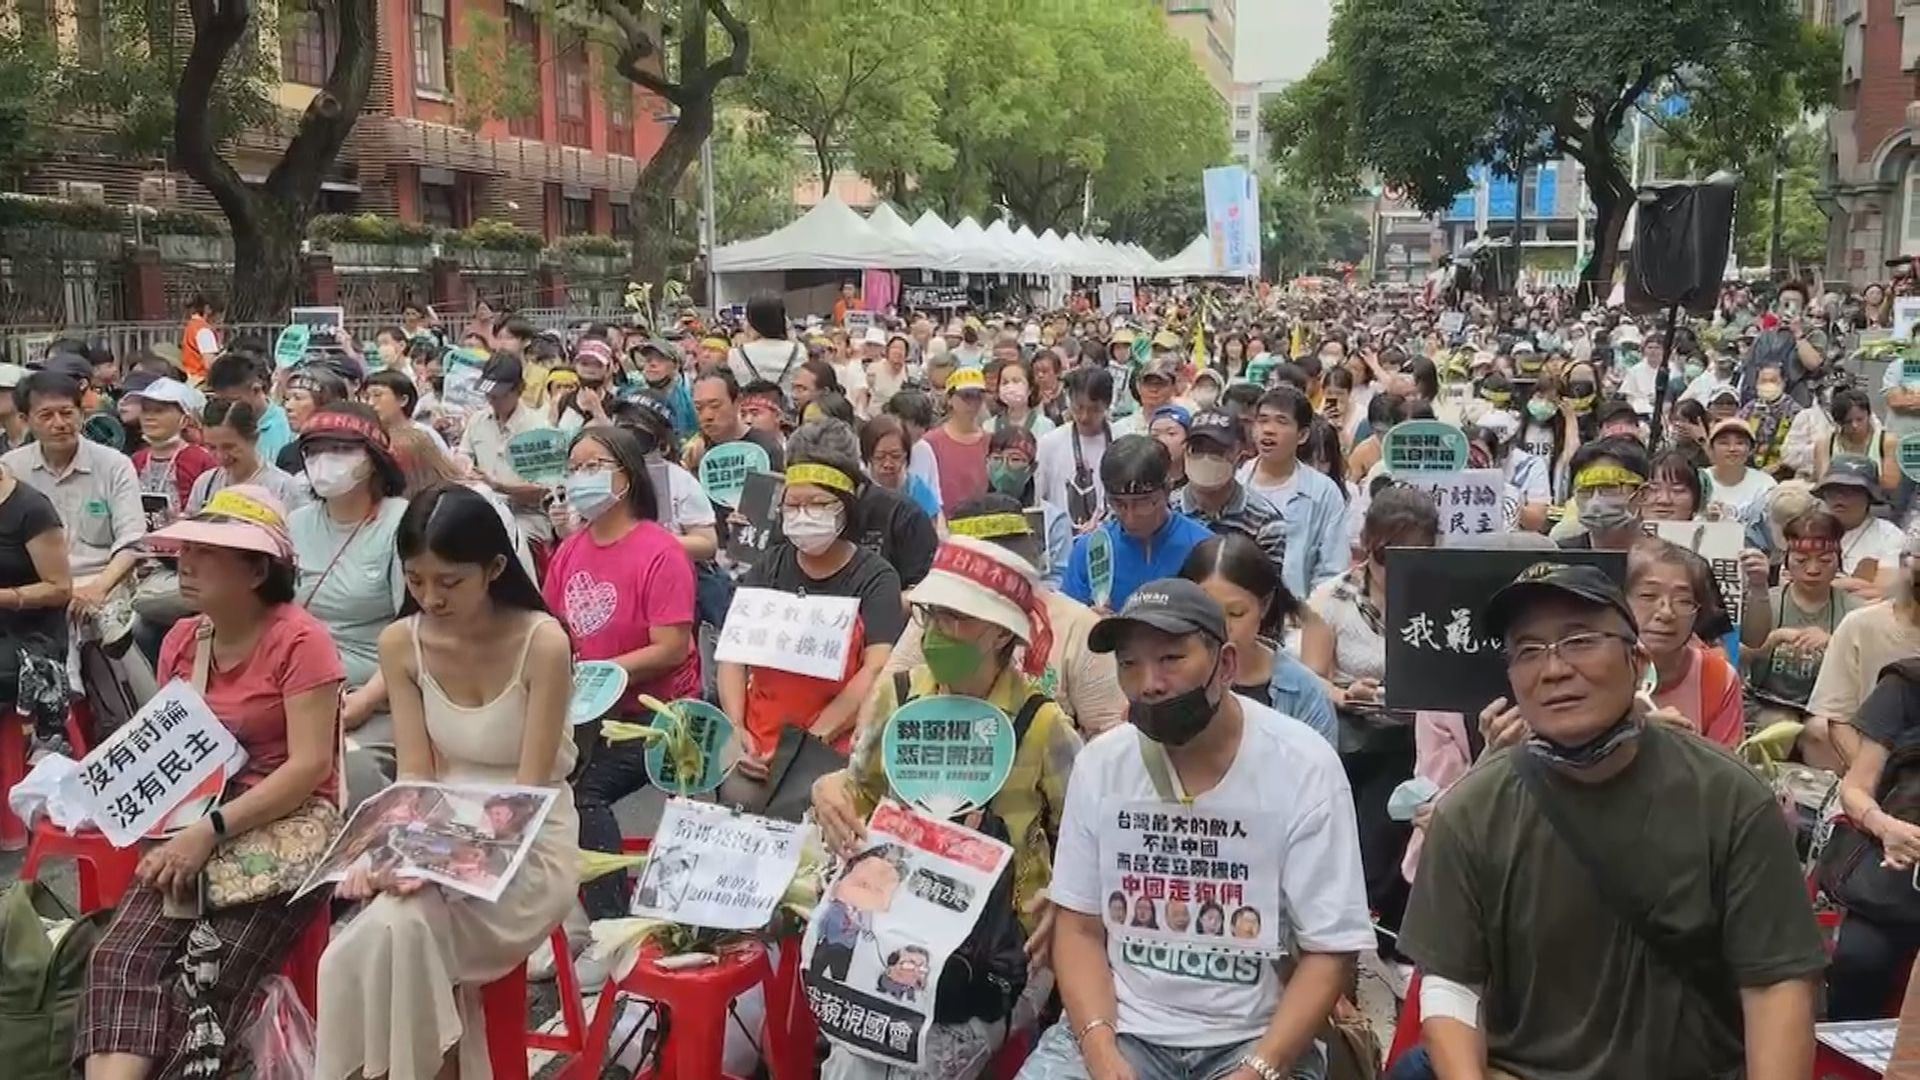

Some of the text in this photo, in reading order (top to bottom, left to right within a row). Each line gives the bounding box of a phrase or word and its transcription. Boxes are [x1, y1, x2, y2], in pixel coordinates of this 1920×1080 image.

[79, 700, 189, 797] 沒有討論
[107, 729, 219, 829] 沒有民主
[1117, 809, 1248, 839] 台灣最大的敵人
[1143, 833, 1218, 858] 不是中國
[1121, 874, 1245, 906] 中國走狗們
